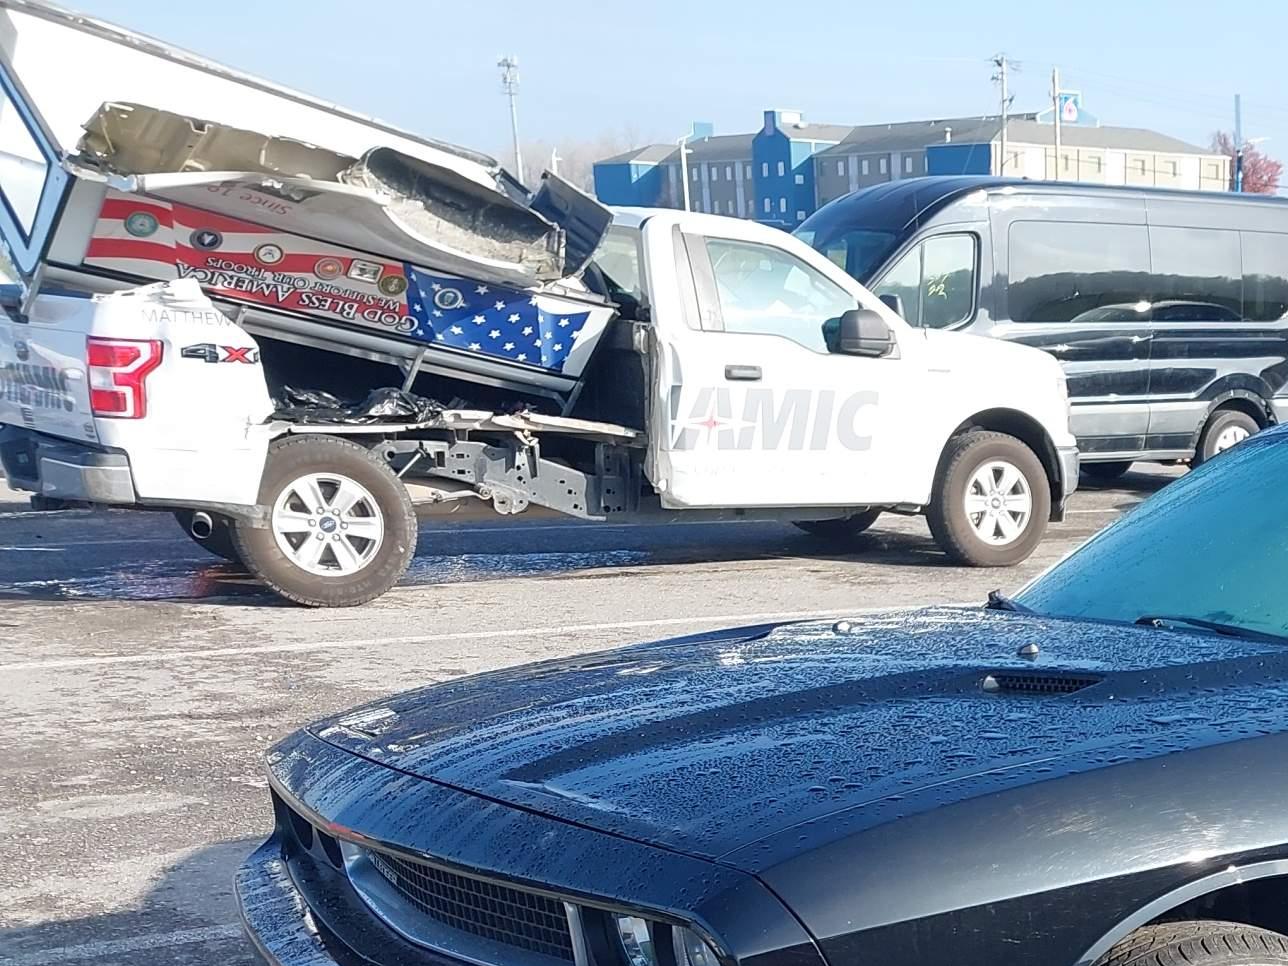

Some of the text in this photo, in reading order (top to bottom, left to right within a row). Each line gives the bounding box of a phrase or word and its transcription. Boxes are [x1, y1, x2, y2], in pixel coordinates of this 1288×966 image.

[176, 262, 419, 333] GOD BLESS AMERICA
[206, 256, 401, 312] WE SUPPORT OUR TROOPS
[181, 343, 259, 364] 4X
